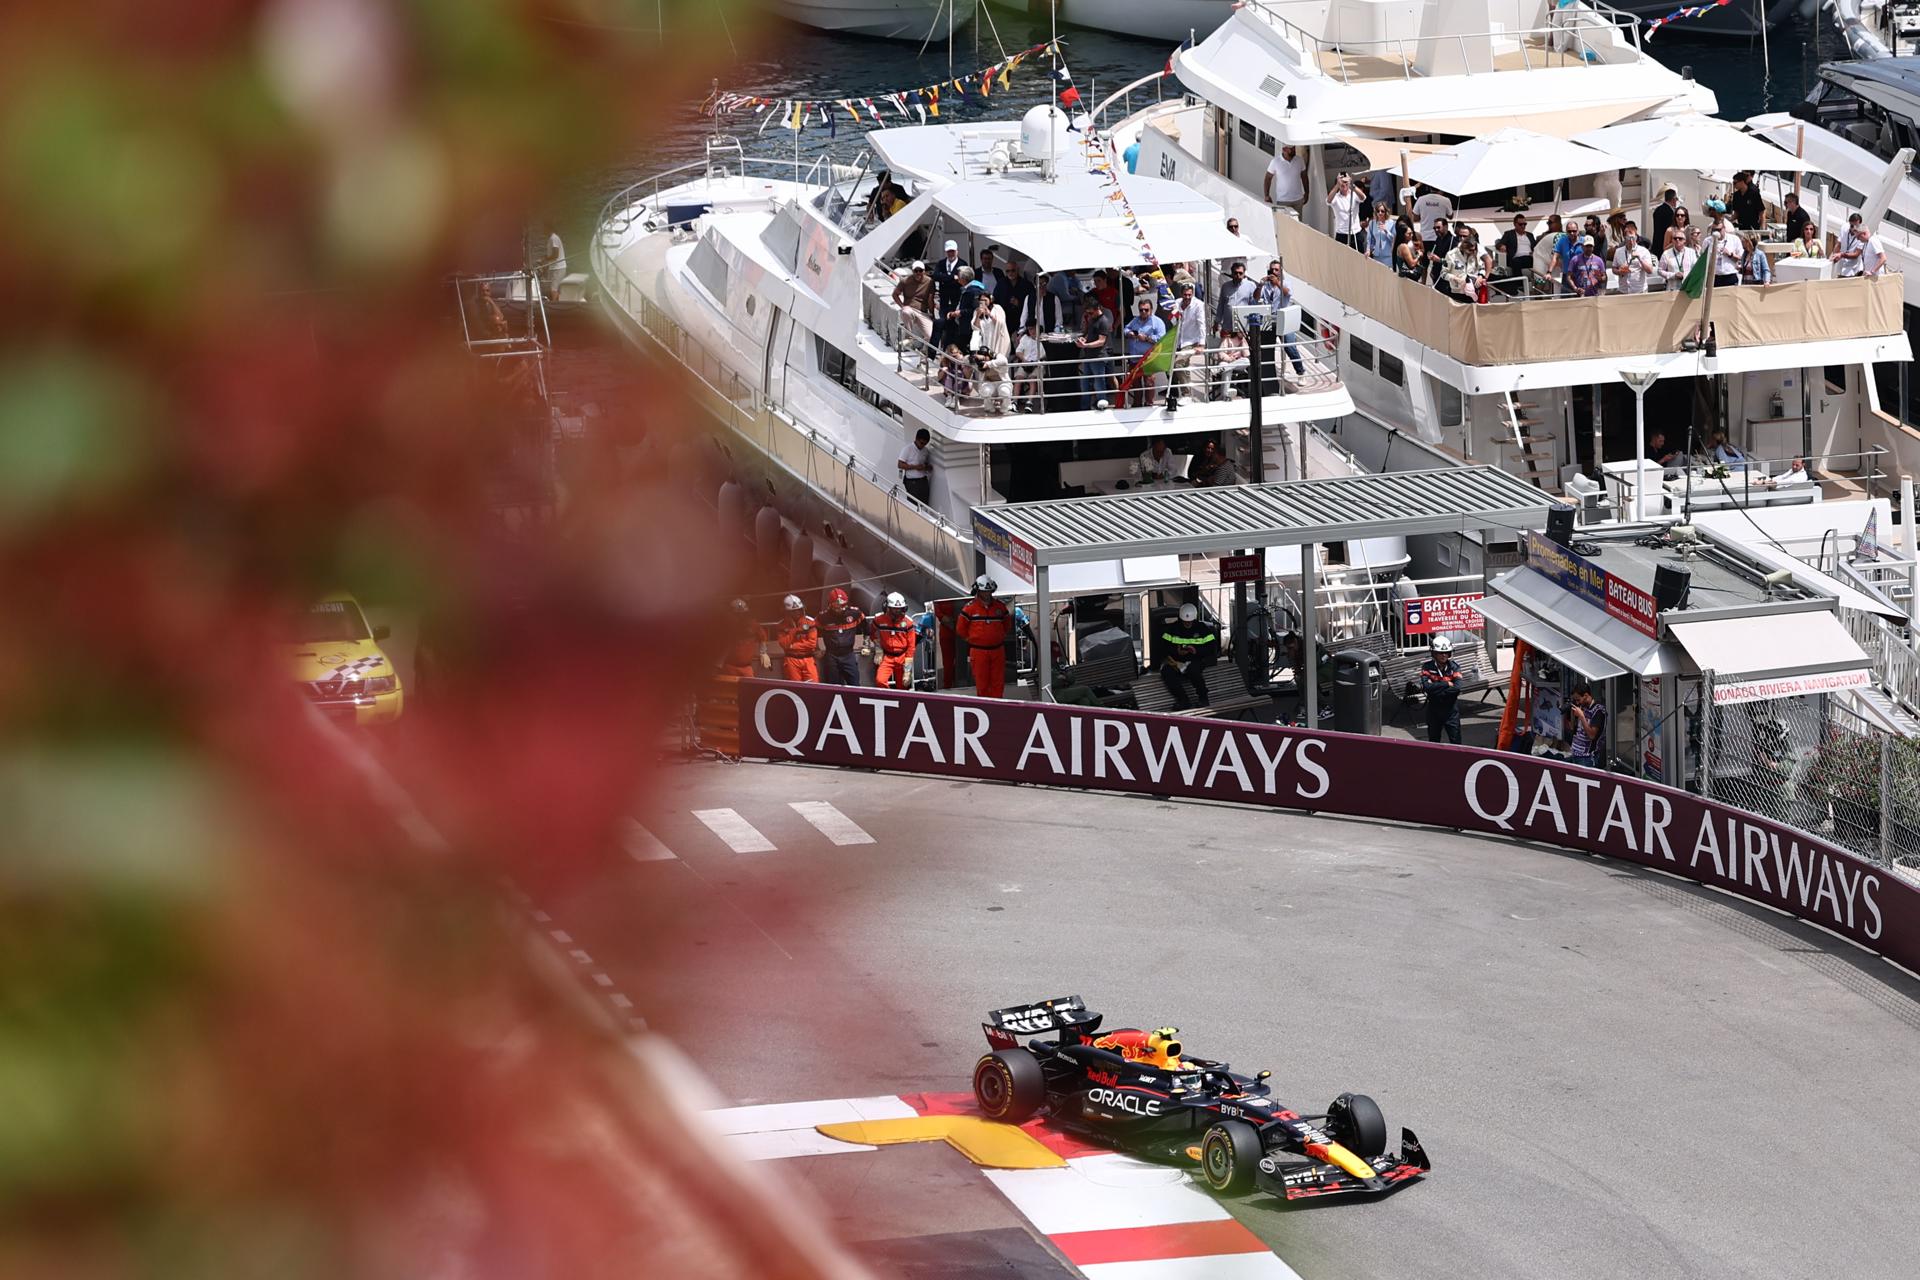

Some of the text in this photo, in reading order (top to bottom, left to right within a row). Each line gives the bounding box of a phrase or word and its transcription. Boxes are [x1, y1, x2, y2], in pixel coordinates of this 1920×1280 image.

[1160, 152, 1176, 181] EVA
[1531, 535, 1578, 577] Promenades
[1579, 566, 1589, 582] en
[1590, 568, 1605, 591] Mer
[1608, 579, 1638, 610] BATEAU
[1638, 596, 1653, 618] BUS
[1714, 673, 1867, 702] MONACO RIVIERA NAVIGATION
[754, 688, 1330, 799] QATAR AIRWAYS
[1464, 759, 1882, 940] QATAR AIRWAYS
[1101, 1071, 1118, 1088] Bull
[1088, 1088, 1163, 1116] ORACLE
[1220, 1104, 1244, 1117] BYBIT
